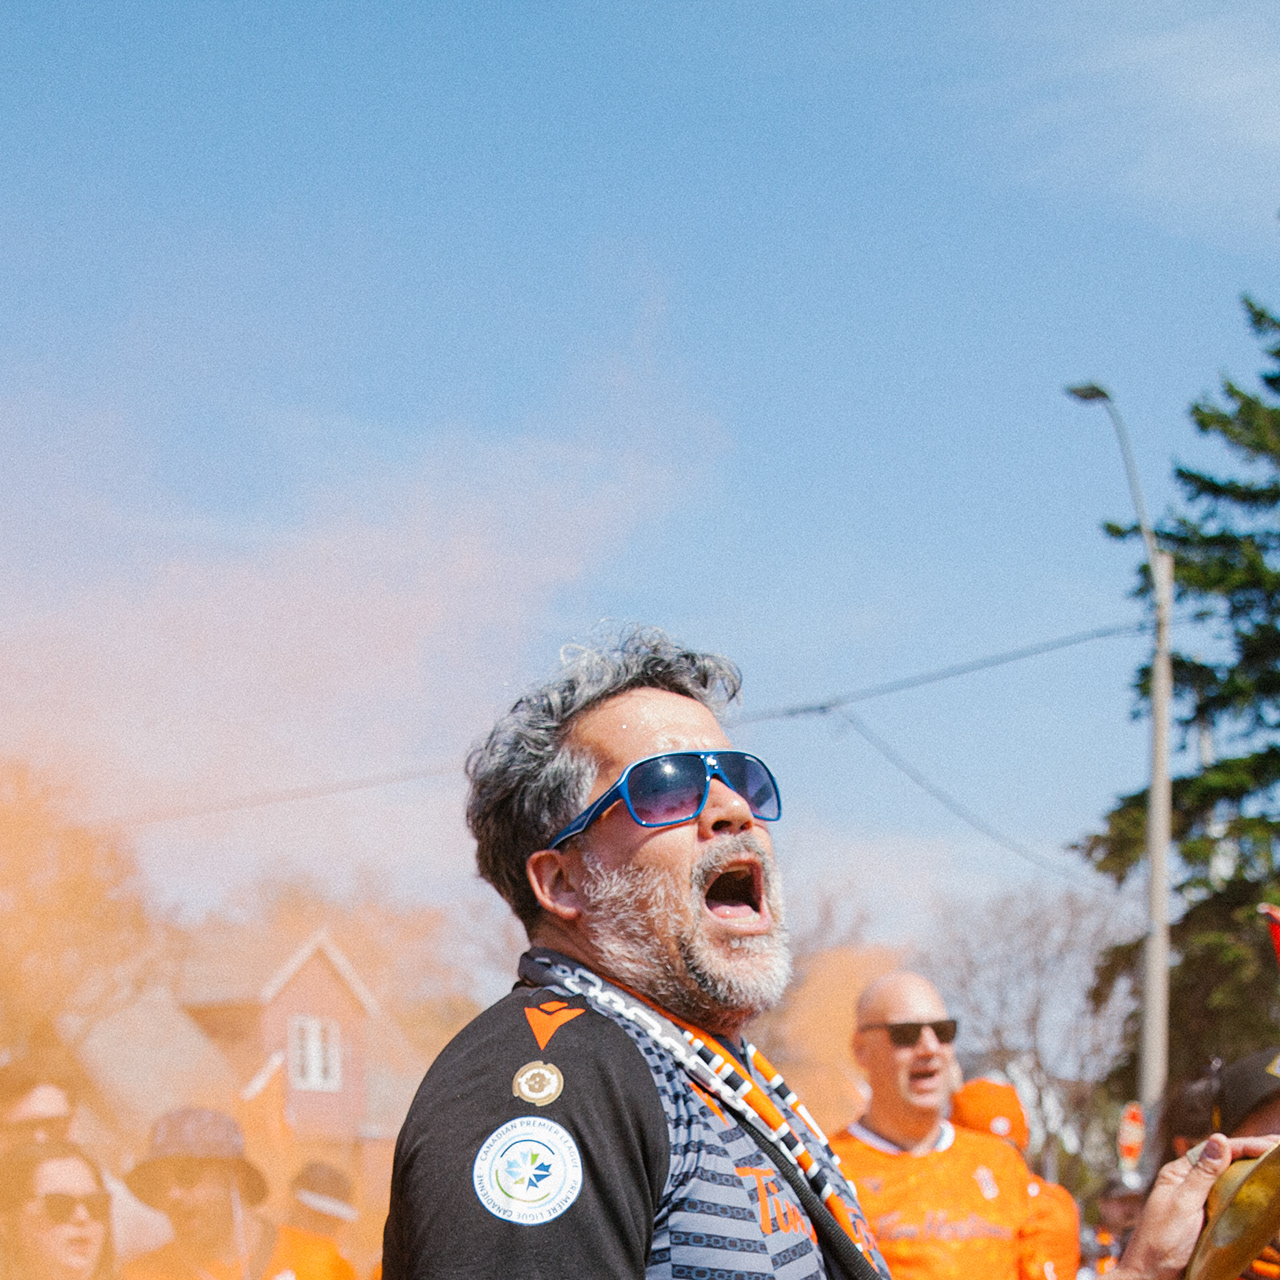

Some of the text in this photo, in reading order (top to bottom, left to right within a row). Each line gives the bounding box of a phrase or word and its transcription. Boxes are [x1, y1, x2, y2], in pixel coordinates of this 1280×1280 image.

[480, 1120, 580, 1169] CANADIAN PREMIER LEAGUE
[476, 1173, 514, 1219] CANADIENNE
[517, 1212, 545, 1222] LIGUE
